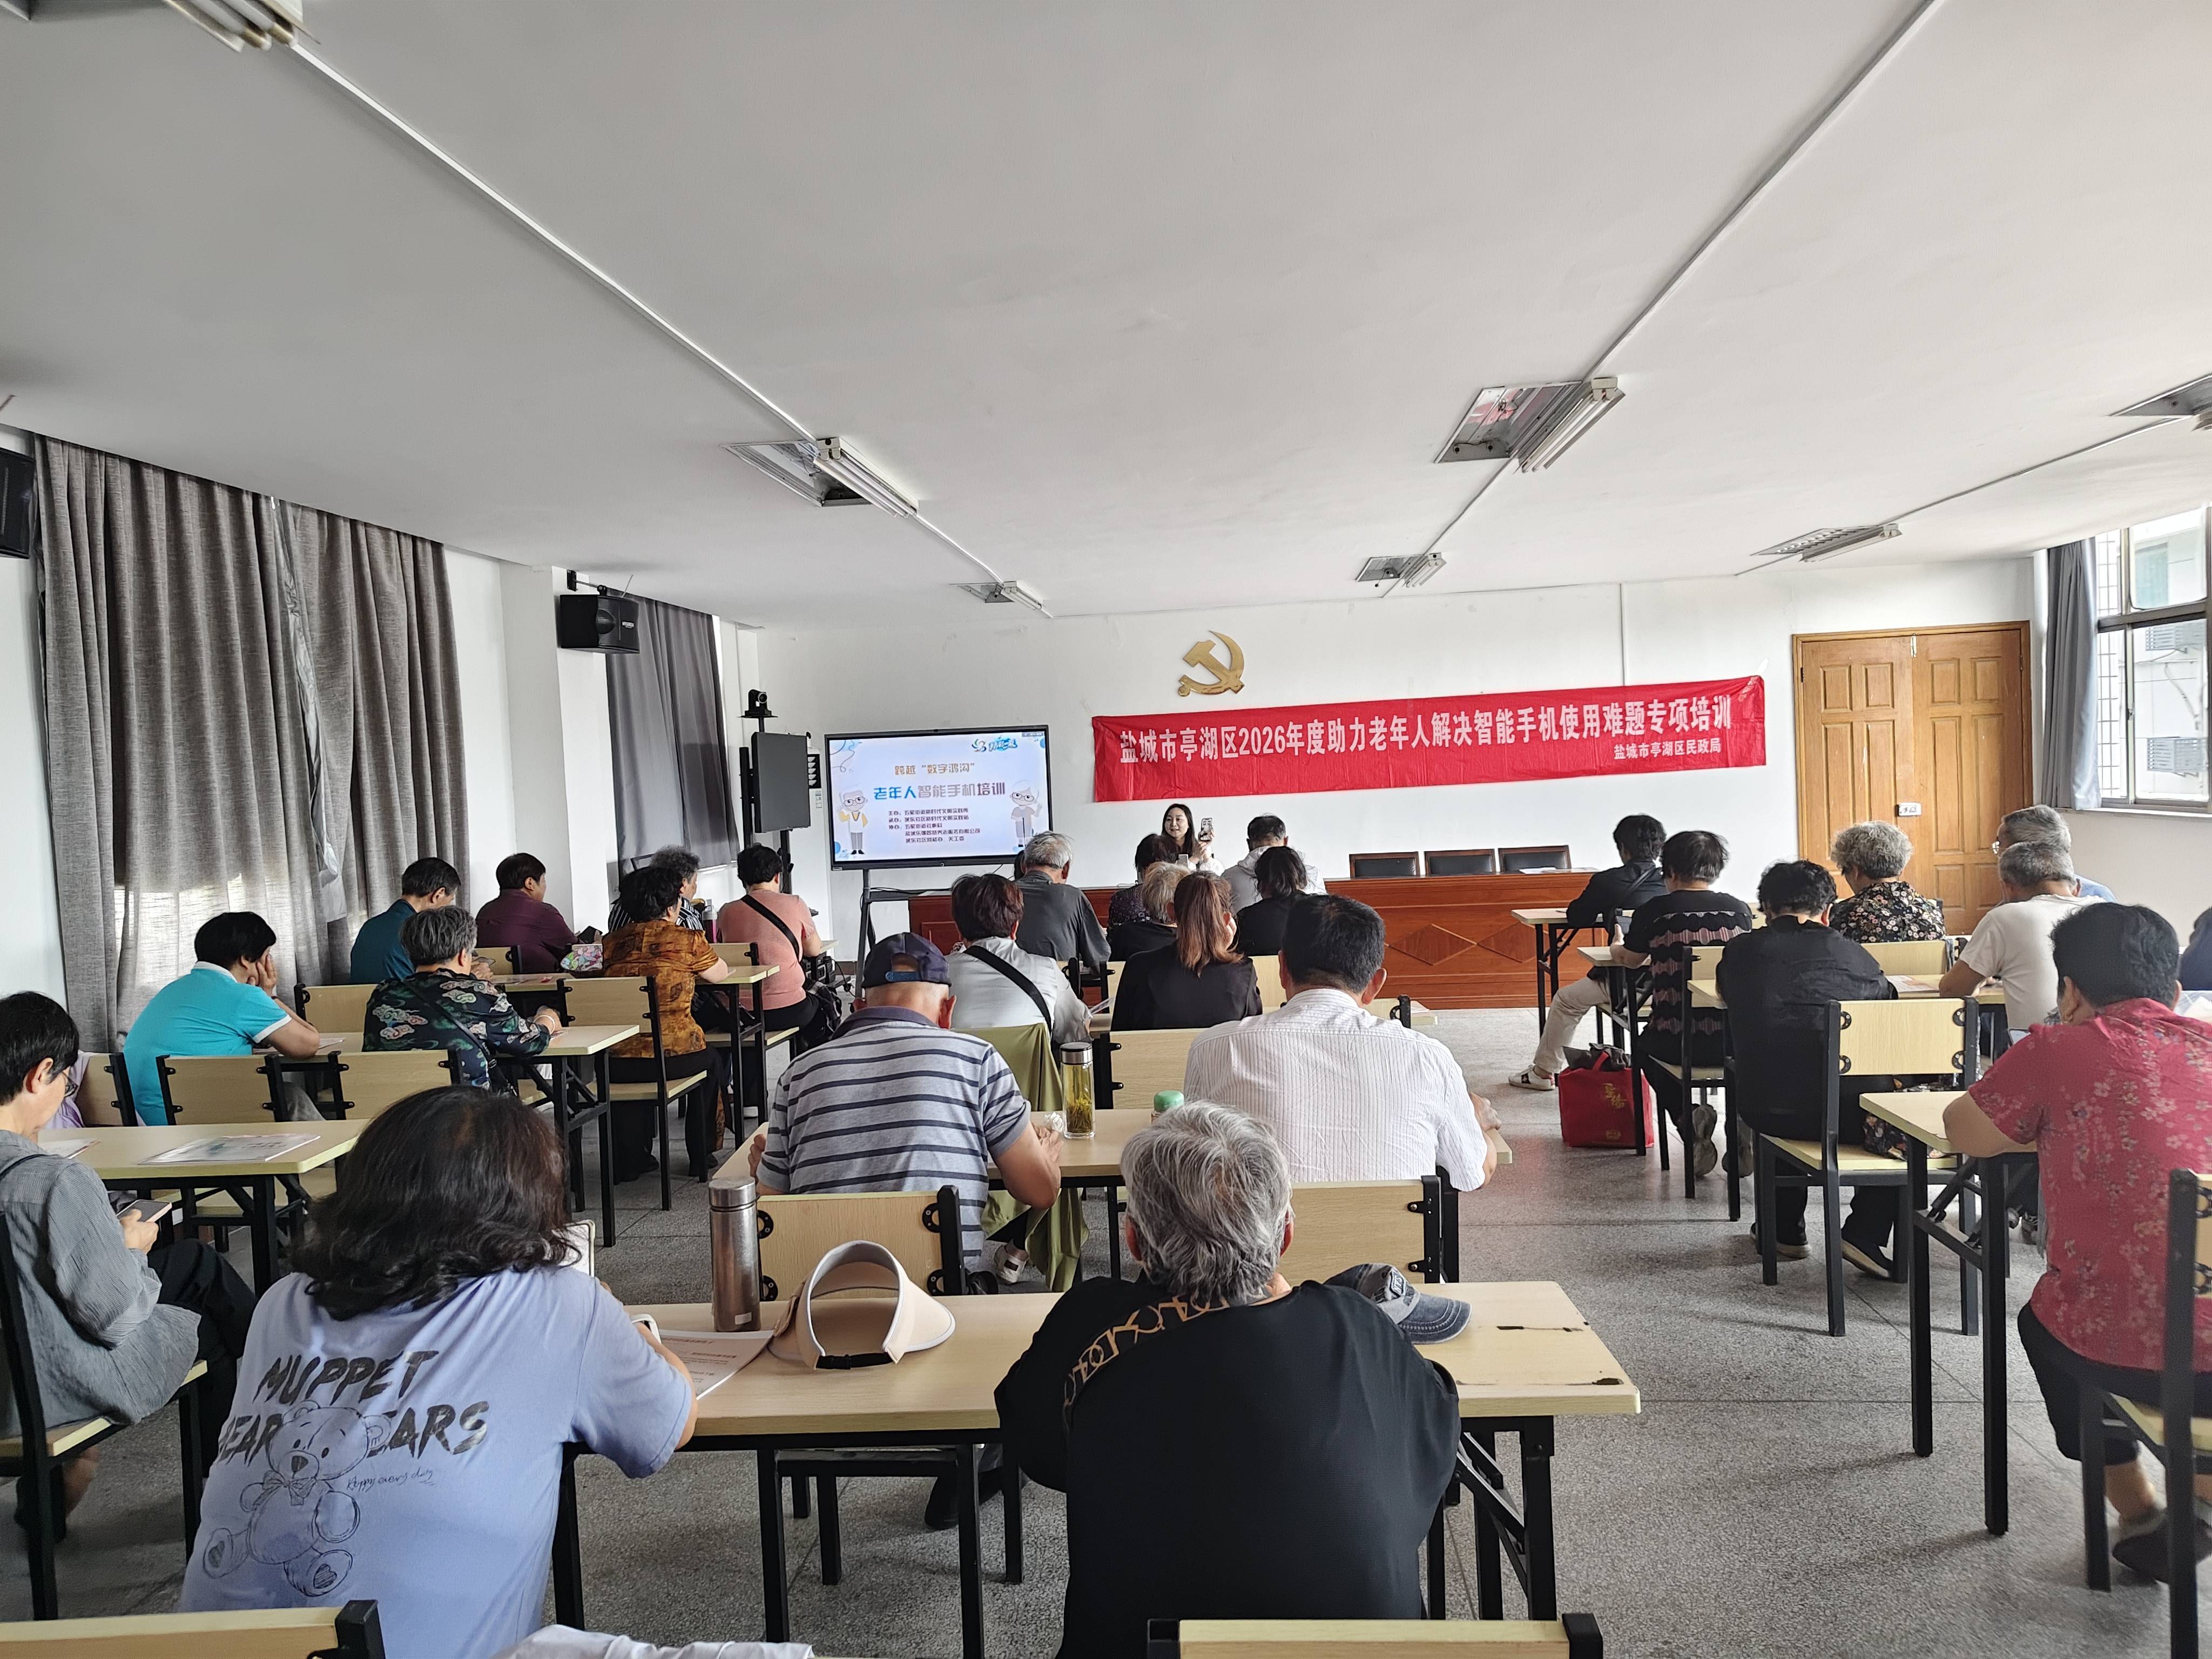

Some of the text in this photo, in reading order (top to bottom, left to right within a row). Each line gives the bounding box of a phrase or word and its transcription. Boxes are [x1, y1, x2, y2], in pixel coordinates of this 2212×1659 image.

[1120, 694, 1731, 763] 盐城市亭湖区2026年度助力老年人解决智能手机使用难题专项培训
[1614, 738, 1722, 760] 盐城市亭湖区民政局
[873, 782, 1006, 800] 老年人智能手机培训
[252, 1350, 439, 1406] MUPPET
[217, 1401, 489, 1467] EAR ARS
